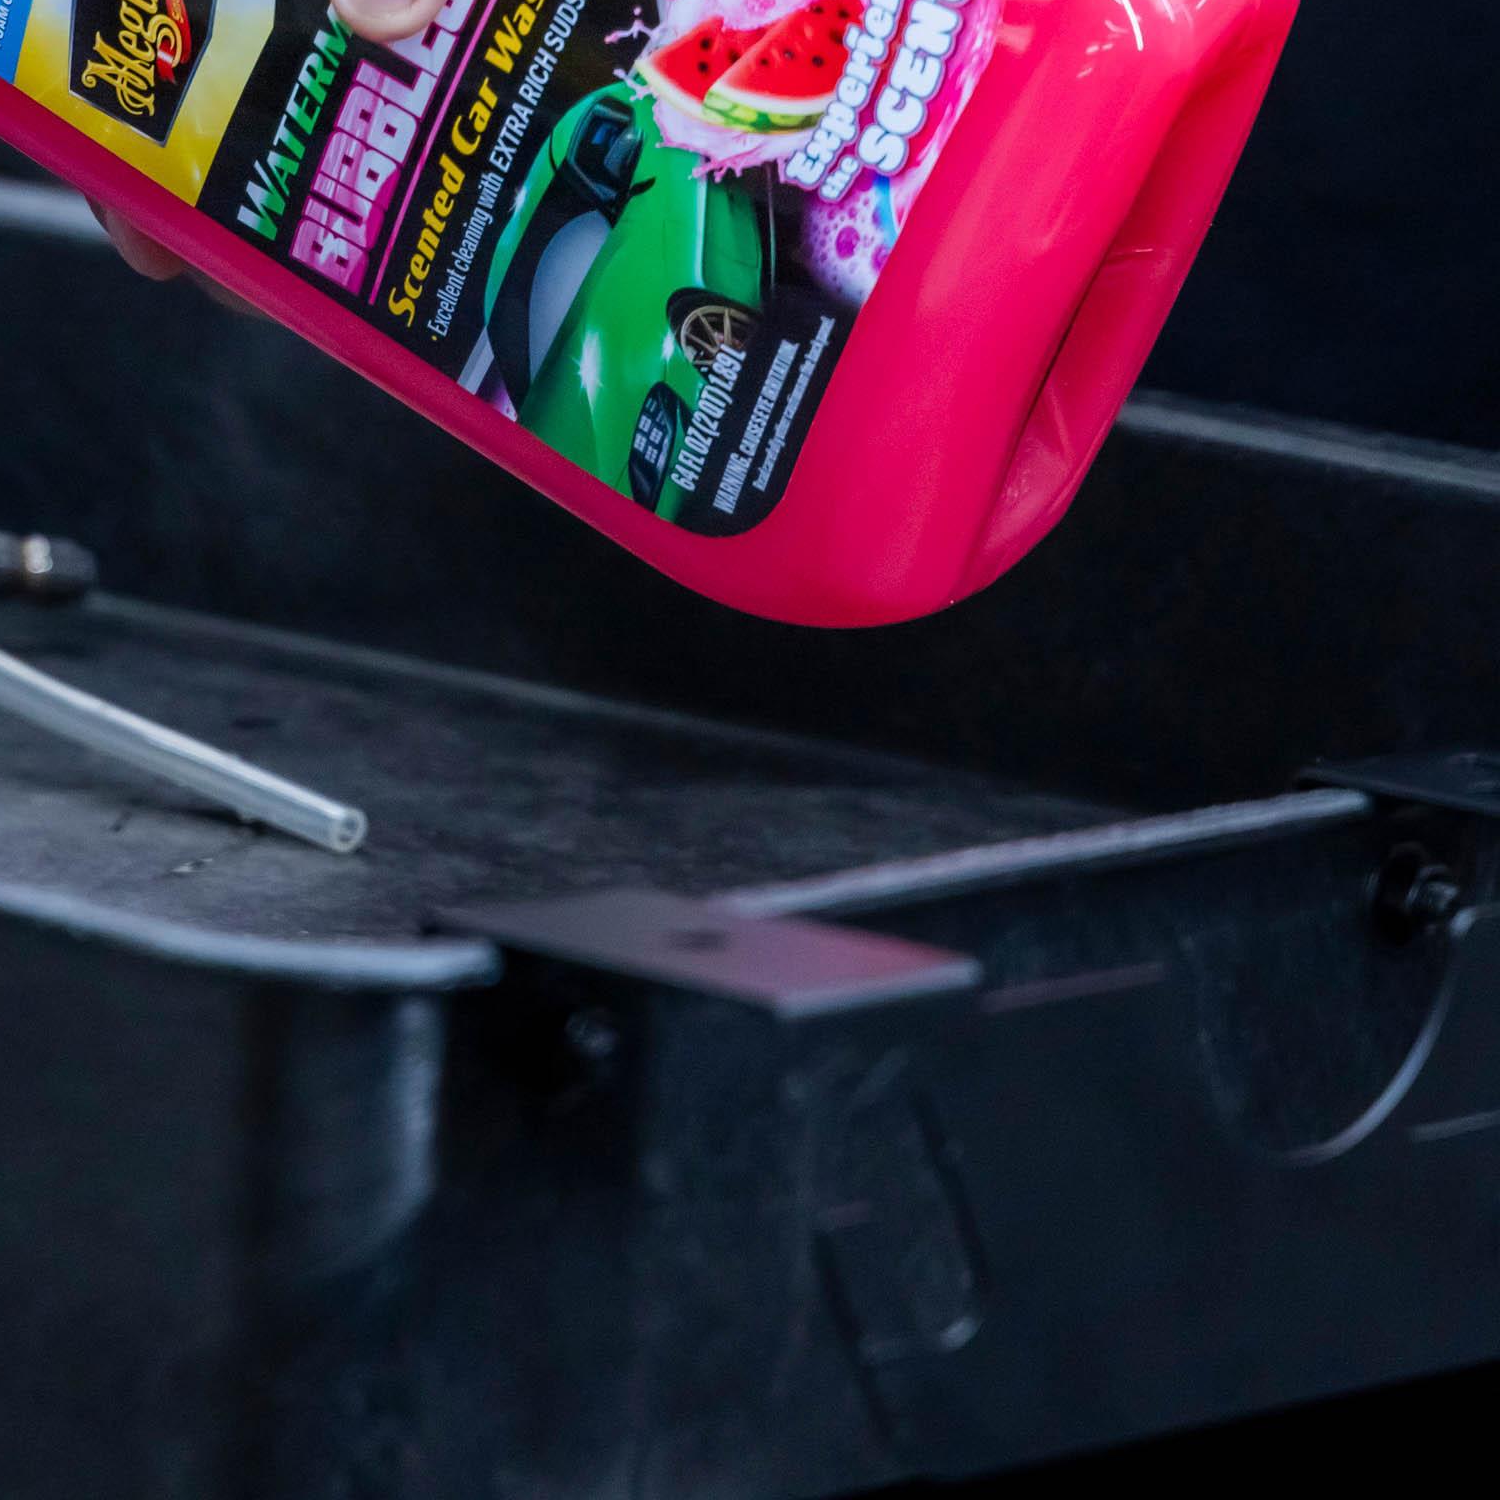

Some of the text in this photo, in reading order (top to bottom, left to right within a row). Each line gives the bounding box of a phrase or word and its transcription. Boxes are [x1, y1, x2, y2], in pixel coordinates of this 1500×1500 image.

[518, 46, 559, 107] RICH
[489, 101, 535, 173] EXTRA
[388, 153, 466, 328] Scented
[451, 76, 499, 156] Car
[478, 171, 505, 211] with
[819, 155, 860, 201] the
[452, 209, 494, 272] cleaning
[427, 268, 466, 337] Excellent
[677, 448, 704, 472] FL
[683, 426, 713, 454] OZ
[670, 464, 698, 490] 64
